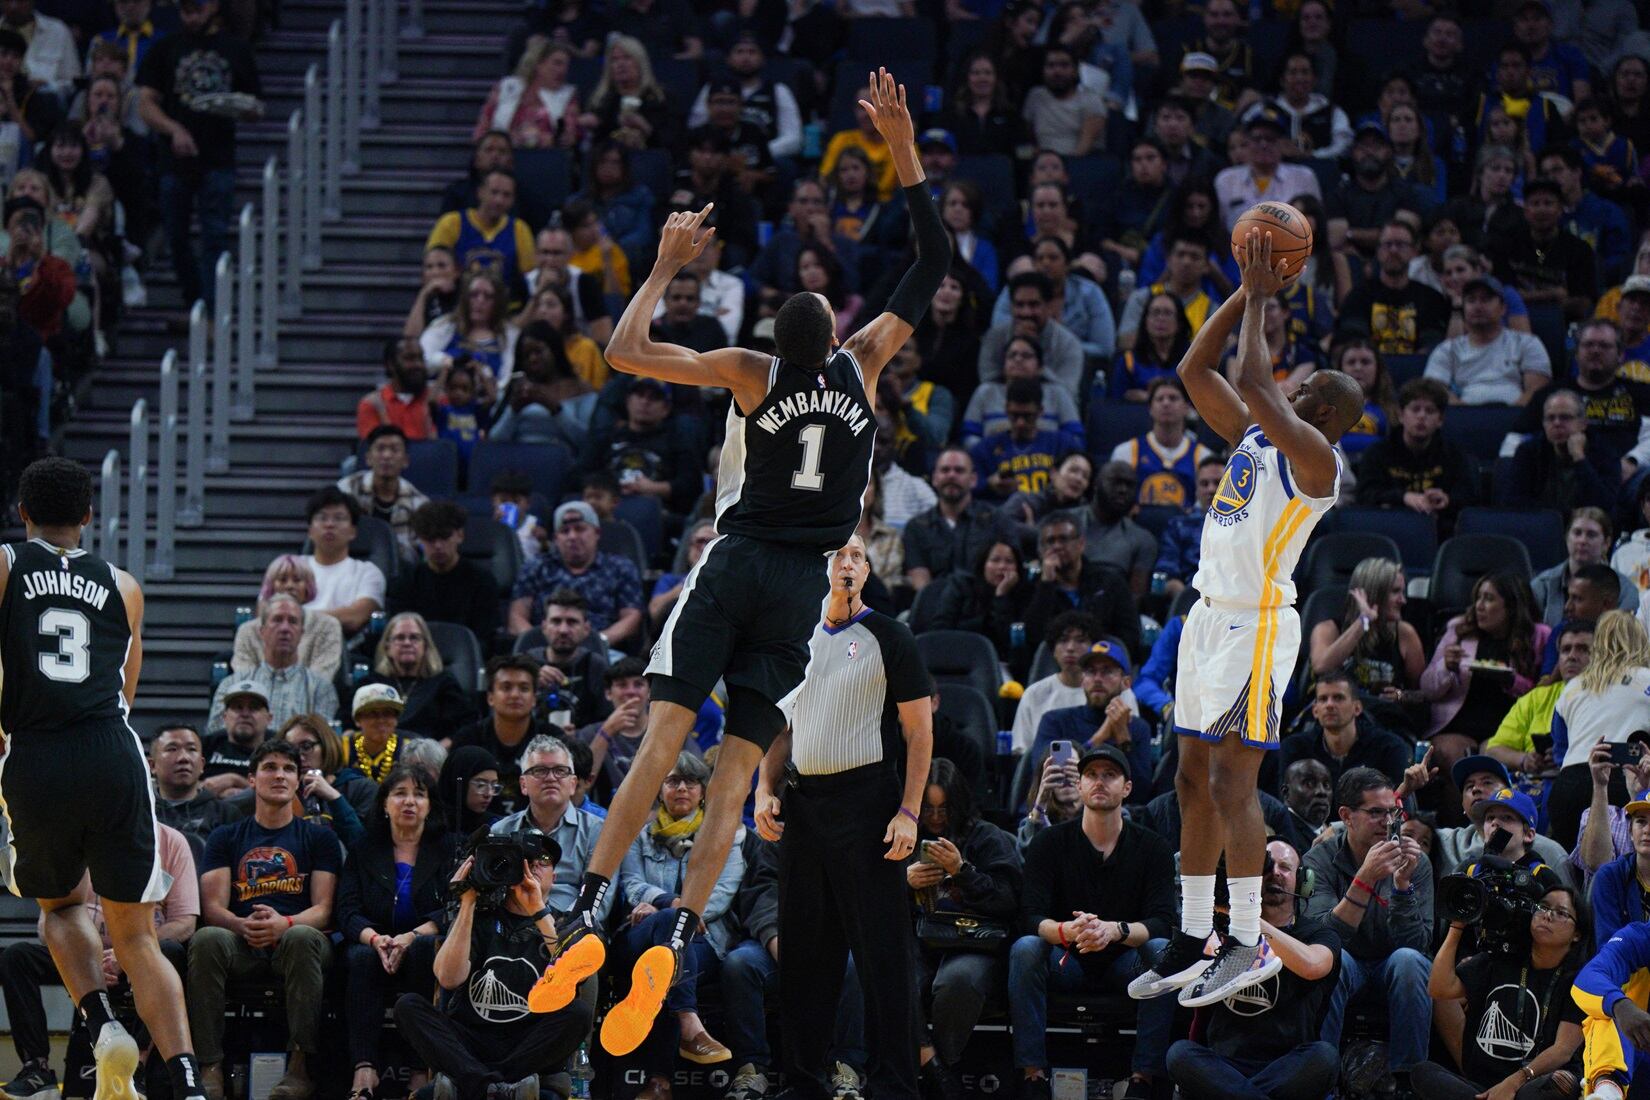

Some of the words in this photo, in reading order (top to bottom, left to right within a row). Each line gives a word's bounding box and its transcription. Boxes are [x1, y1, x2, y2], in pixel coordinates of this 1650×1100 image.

[756, 390, 869, 437] WEMBANYAMA
[790, 423, 826, 492] 1
[1237, 468, 1251, 488] 3
[1207, 507, 1249, 527] ARRIORS
[22, 570, 110, 611] JOHNSON
[38, 606, 91, 683] 3
[239, 876, 304, 902] WARRIORS
[624, 1069, 704, 1087] CHSE
